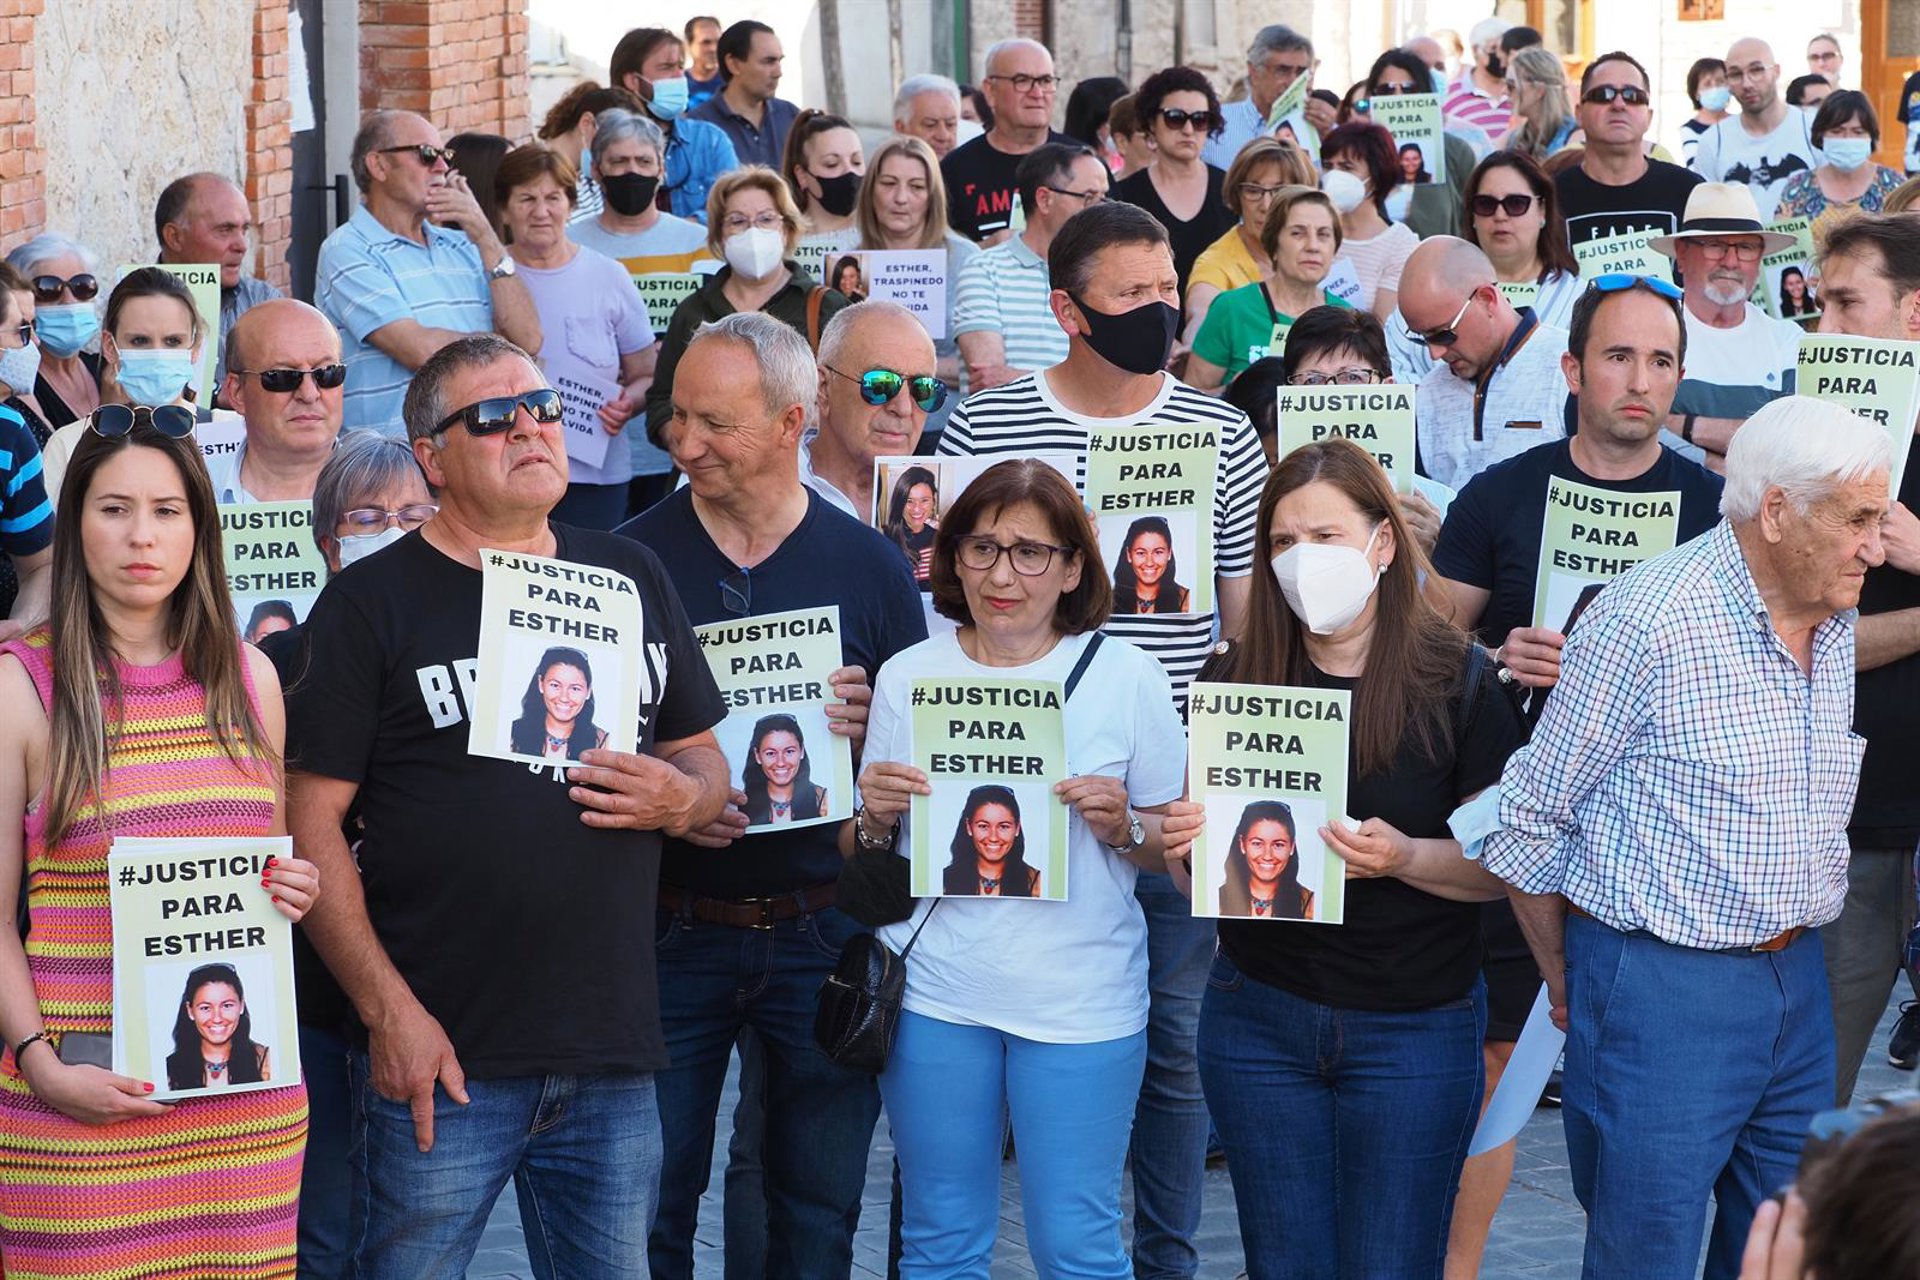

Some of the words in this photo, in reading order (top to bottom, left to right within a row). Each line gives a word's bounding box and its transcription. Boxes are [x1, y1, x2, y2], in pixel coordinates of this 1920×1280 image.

[1388, 115, 1423, 124] PARA
[1392, 128, 1432, 139] STHER
[1579, 238, 1650, 260] #JUSTIC
[1762, 250, 1807, 267] ESTHER
[803, 264, 821, 274] RA
[885, 264, 932, 273] ESTHER,
[1603, 258, 1646, 273] PARA
[633, 280, 699, 291] USTICIA
[873, 277, 944, 286] TRASPINEDO
[892, 290, 908, 299] NO
[912, 290, 926, 299] TE
[1797, 346, 1915, 368] #JUSTICIA
[558, 377, 605, 401] ESTHER,
[1817, 377, 1878, 395] PARA
[1280, 394, 1411, 413] #JUSTICIA
[561, 417, 594, 436] LVIDA
[579, 410, 593, 422] TE
[1090, 431, 1217, 452] #JUSTICIA
[1312, 423, 1378, 441] PARA
[1119, 462, 1183, 481] PARA
[1100, 489, 1196, 511] ESTHER
[1549, 486, 1675, 519] #JUSTICIA
[221, 510, 313, 531] JUSTICI
[1570, 523, 1640, 547] PARA
[234, 541, 301, 561] PARA
[1552, 549, 1646, 576] ESTHE
[489, 554, 635, 596] #JUSTICIA
[527, 583, 602, 613] PARA
[508, 608, 619, 645] ESTHER
[698, 616, 834, 648] #JUSTICIA
[730, 651, 803, 675] PARA
[721, 681, 823, 708] ESTHER
[912, 686, 1061, 710] #JUSTICIA
[1191, 694, 1344, 722] #JUSTICIA
[949, 720, 1026, 741] PARA
[1226, 731, 1305, 755] PARA
[930, 753, 1044, 776] ESTHER
[1206, 766, 1322, 792] ESTHER
[161, 892, 245, 920] PARA
[144, 926, 266, 957] ESTHER
